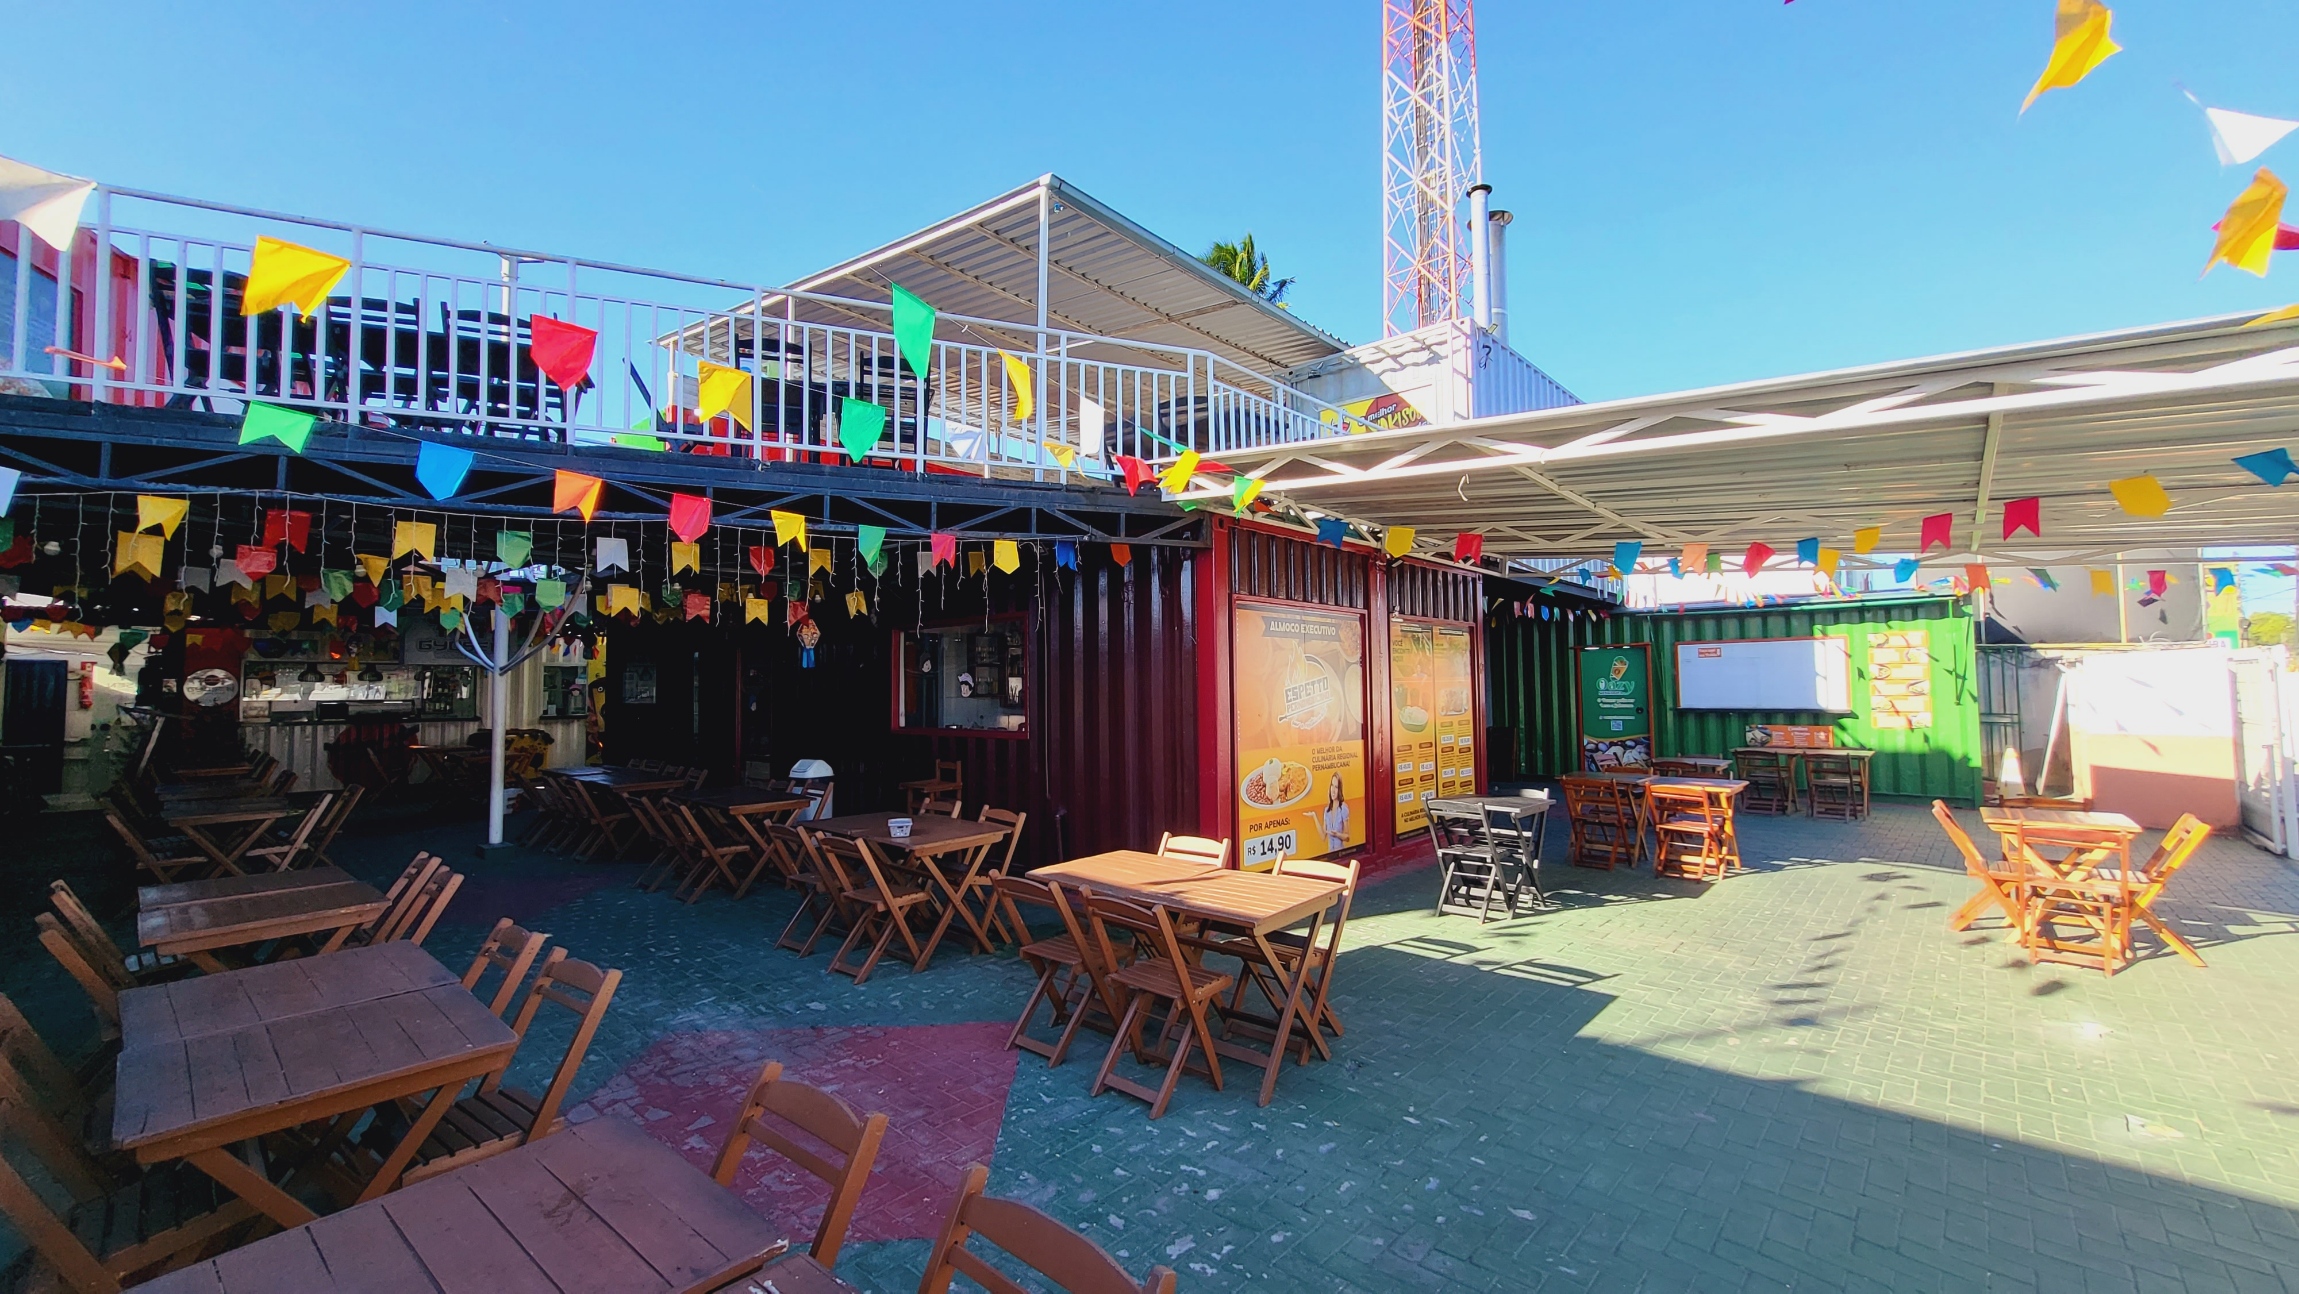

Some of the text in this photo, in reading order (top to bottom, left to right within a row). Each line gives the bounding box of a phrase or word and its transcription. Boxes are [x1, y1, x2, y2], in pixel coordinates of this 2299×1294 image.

[1367, 403, 1397, 422] melhor
[1300, 623, 1336, 636] EXECUTIVO
[418, 639, 494, 650] GYOSE
[1284, 676, 1329, 704] ESPETTO
[1316, 746, 1335, 755] MELHOR
[1335, 745, 1343, 753] DA
[1336, 751, 1359, 761] REGIONAL
[1249, 817, 1291, 833] POR APENAS:
[1247, 834, 1291, 857] R$ 14,90
